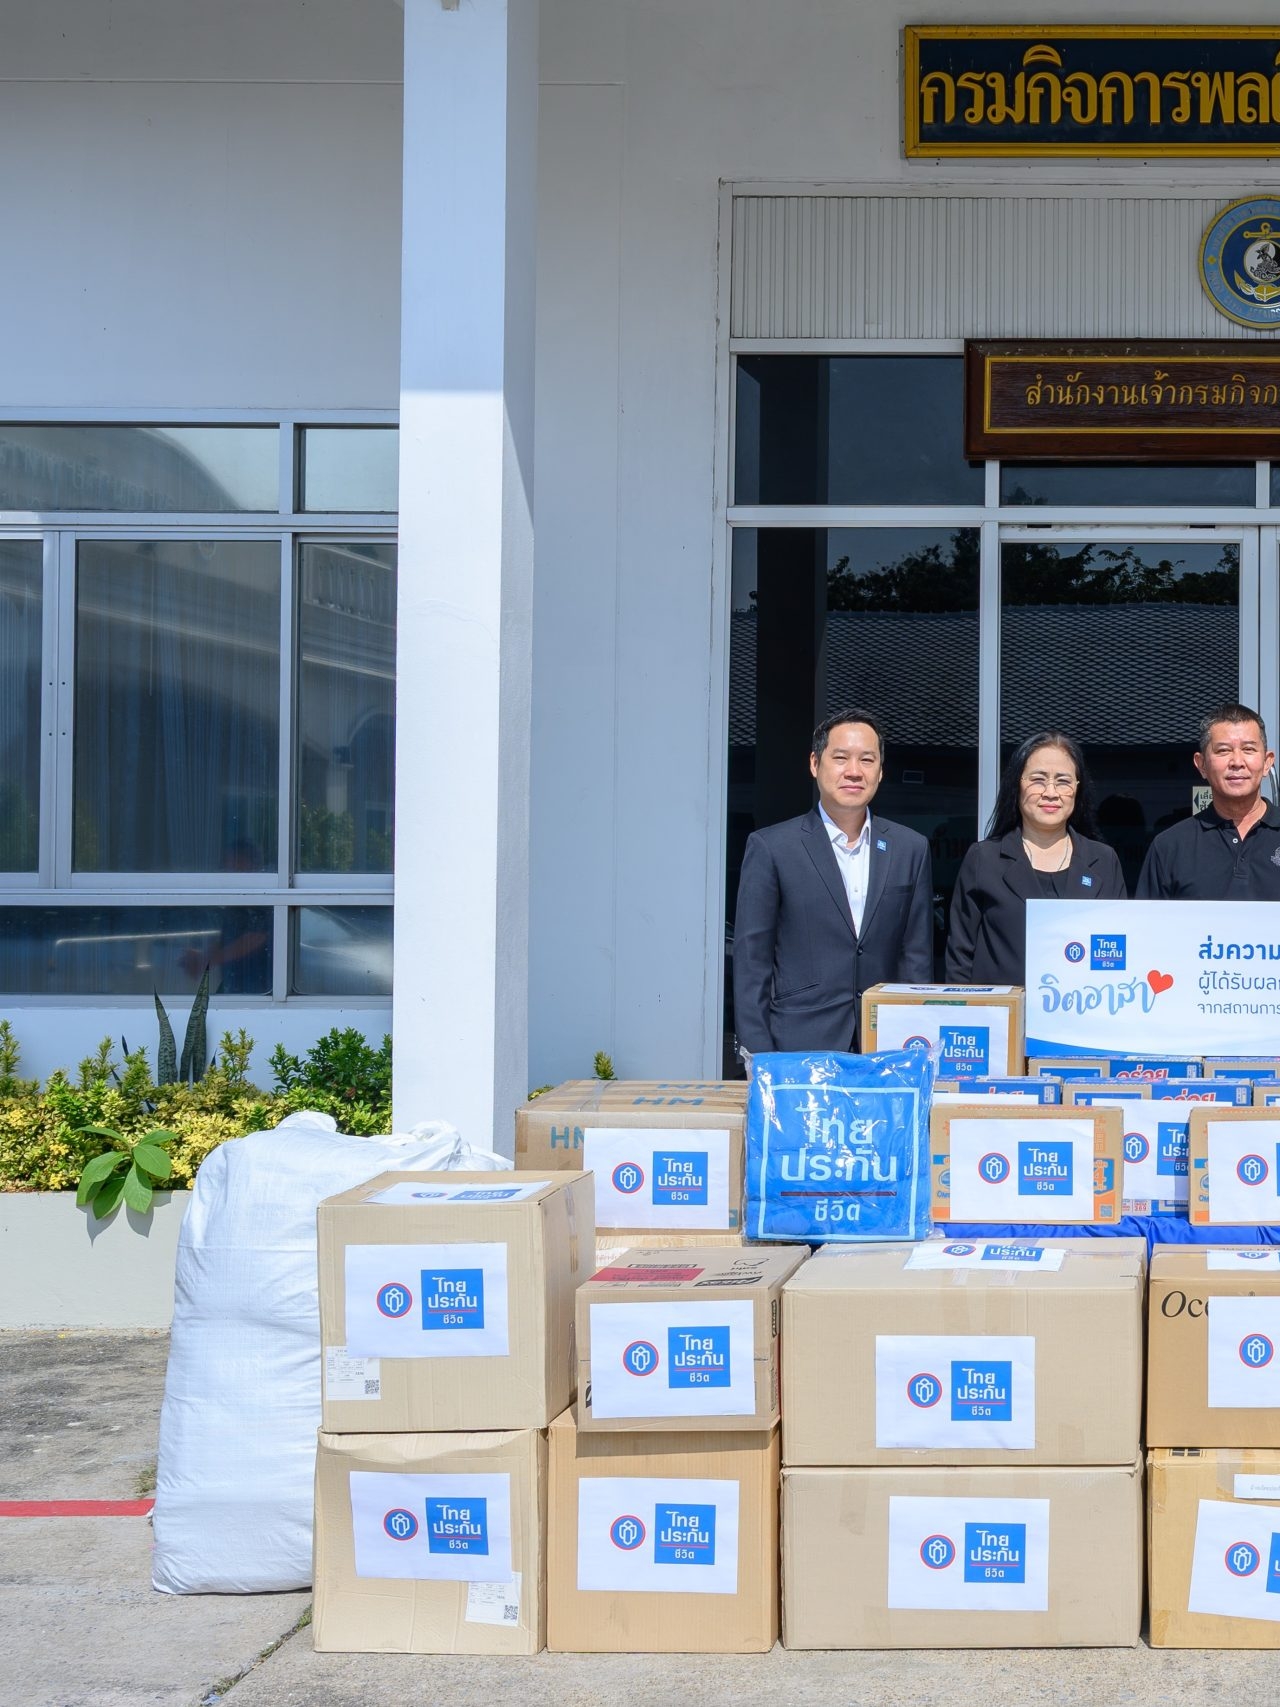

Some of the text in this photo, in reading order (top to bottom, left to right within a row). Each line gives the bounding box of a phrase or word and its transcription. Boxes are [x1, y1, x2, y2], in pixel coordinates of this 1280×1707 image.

[1097, 938, 1117, 948] ไทย
[1093, 949, 1122, 957] ประกัน
[1038, 973, 1156, 1016] จิตอาสา
[947, 1030, 977, 1046] ไทย
[943, 1045, 984, 1058] ประกัน
[955, 1061, 971, 1071] ชีวิต
[632, 1097, 704, 1106] HM
[795, 1105, 874, 1145] ไทย
[1168, 1128, 1189, 1144] ไท
[1027, 1148, 1058, 1163] ไทย
[1162, 1143, 1189, 1157] ประ
[662, 1158, 693, 1173] ไทย
[781, 1147, 897, 1182] ประกัน
[1023, 1162, 1068, 1177] ประกัน
[657, 1172, 703, 1187] ประกัน
[1036, 1181, 1055, 1191] ชีวิต
[671, 1191, 689, 1201] ชีวิต
[814, 1199, 861, 1222] ชีวิต
[431, 1277, 466, 1293] ไทย
[428, 1293, 478, 1308] ประกัน
[443, 1314, 463, 1324] ชีวิต
[678, 1334, 713, 1351] ไทย
[674, 1350, 724, 1367] ประกัน
[689, 1373, 710, 1382] ชีวิต
[961, 1368, 995, 1385] ไทย
[957, 1384, 1006, 1400] ประกัน
[971, 1405, 992, 1417] ชีวิต
[435, 1504, 470, 1521] ไทย
[665, 1511, 699, 1528] ไทย
[433, 1520, 481, 1535] ประกัน
[661, 1527, 709, 1543] ประกัน
[448, 1539, 468, 1550] ชีวิต
[974, 1529, 1009, 1547] ไทย
[675, 1548, 695, 1559] ชีวิต
[970, 1546, 1019, 1562] ประกัน
[984, 1567, 1005, 1578] ชีวิต
